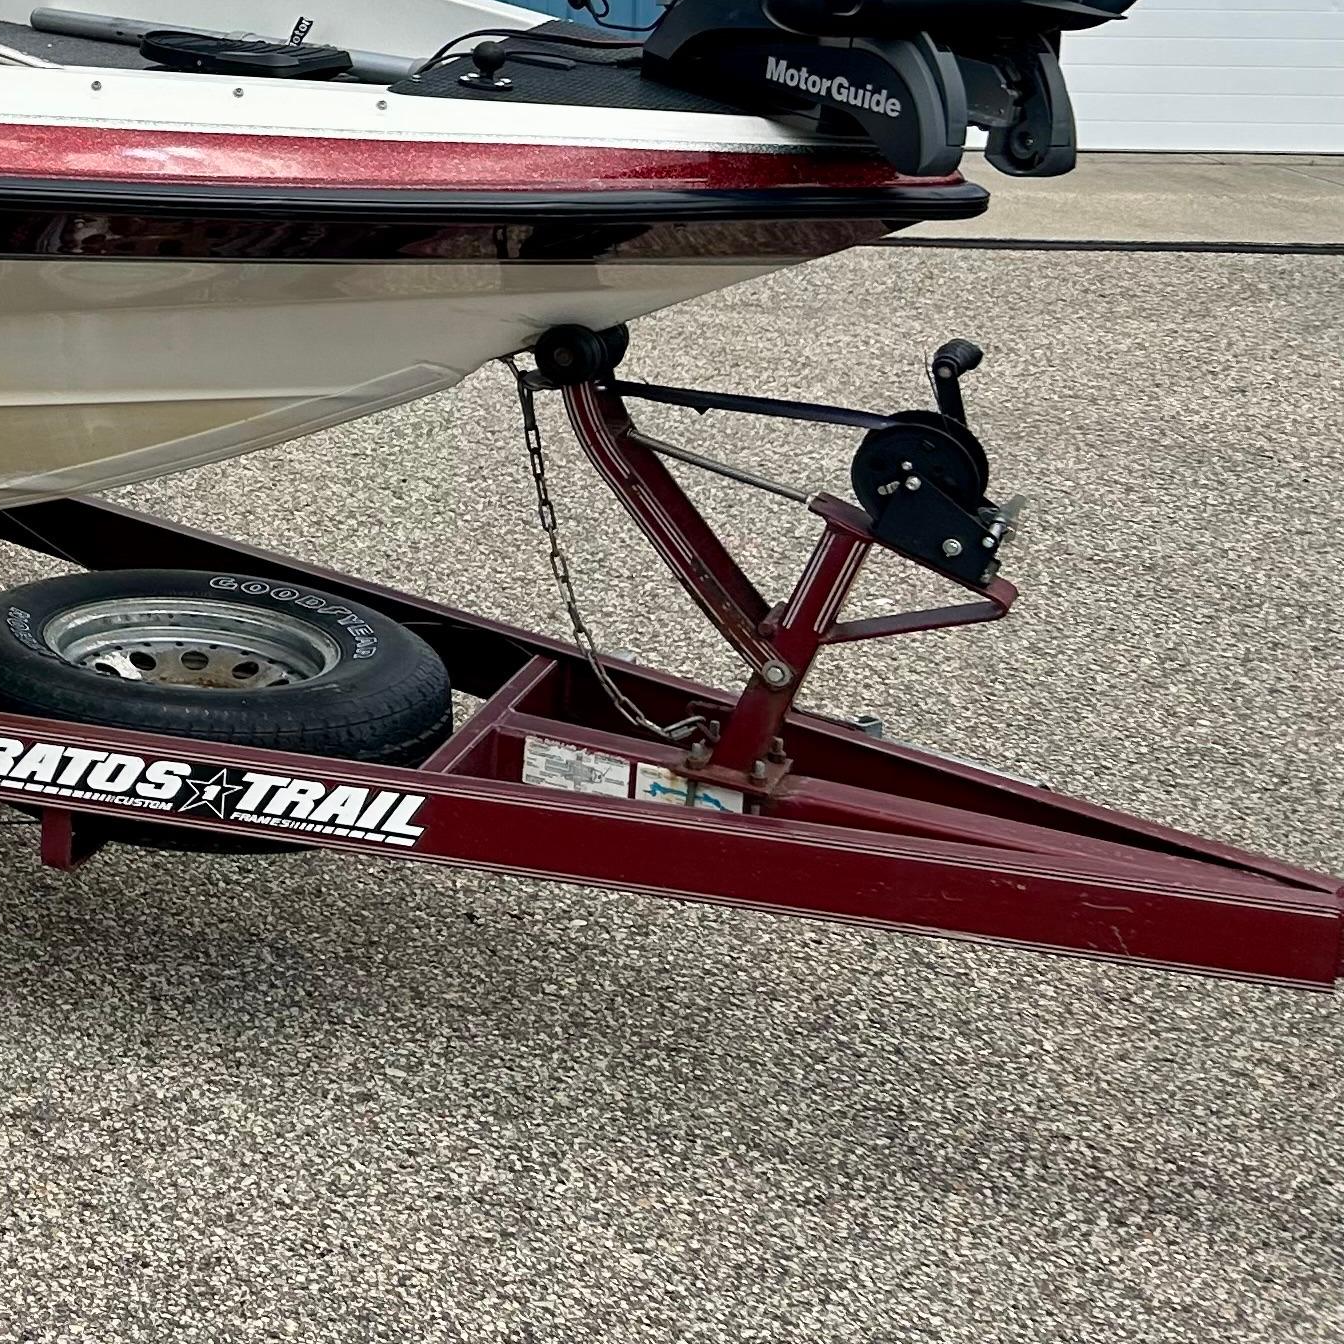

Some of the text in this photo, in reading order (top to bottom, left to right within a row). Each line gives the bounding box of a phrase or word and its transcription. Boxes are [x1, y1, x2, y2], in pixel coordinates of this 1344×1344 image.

[765, 56, 902, 118] MotorGuide
[209, 575, 379, 660] GOODYEAR
[113, 794, 174, 811] CUSTOM
[229, 810, 293, 828] FRAMES
[235, 770, 428, 838] TRAIL
